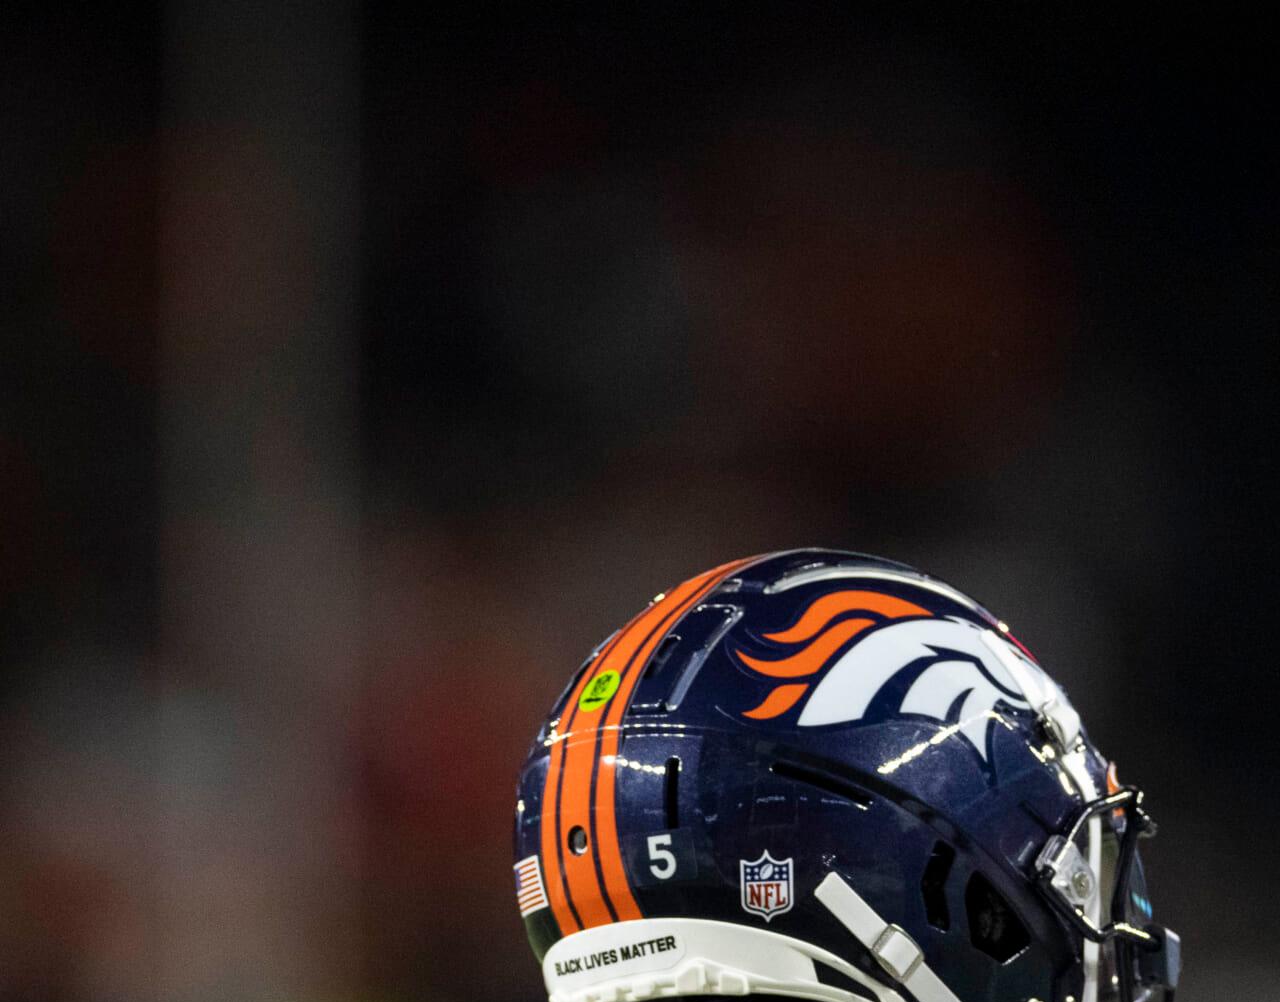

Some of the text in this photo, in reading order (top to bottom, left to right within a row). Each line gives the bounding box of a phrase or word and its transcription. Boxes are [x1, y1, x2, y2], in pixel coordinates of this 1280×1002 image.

[647, 834, 677, 880] 5
[748, 882, 787, 910] NFL
[555, 935, 677, 976] BLACK LIVES MATTER
